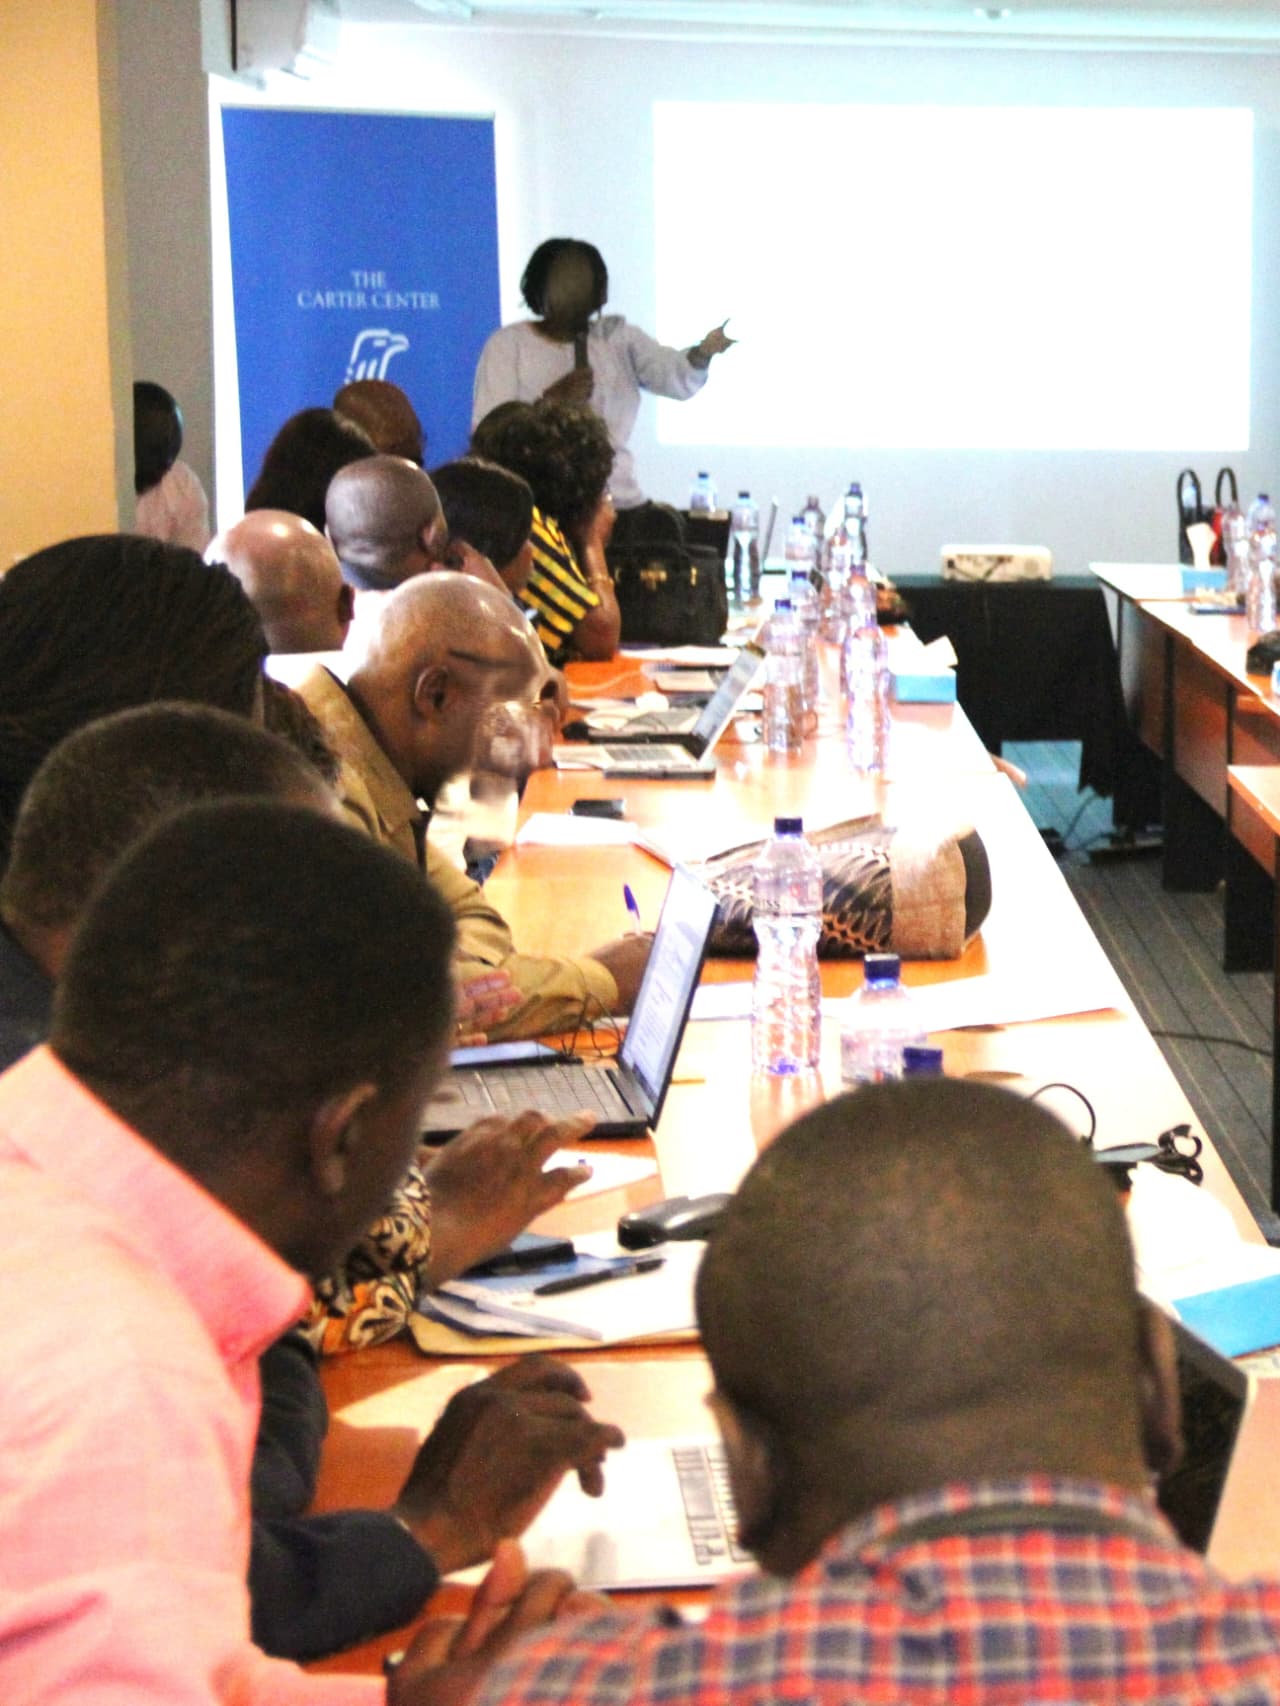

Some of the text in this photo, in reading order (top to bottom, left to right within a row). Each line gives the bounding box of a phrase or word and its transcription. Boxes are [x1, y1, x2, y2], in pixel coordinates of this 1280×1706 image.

[351, 271, 387, 287] THE
[297, 292, 441, 308] CARTER CENTER
